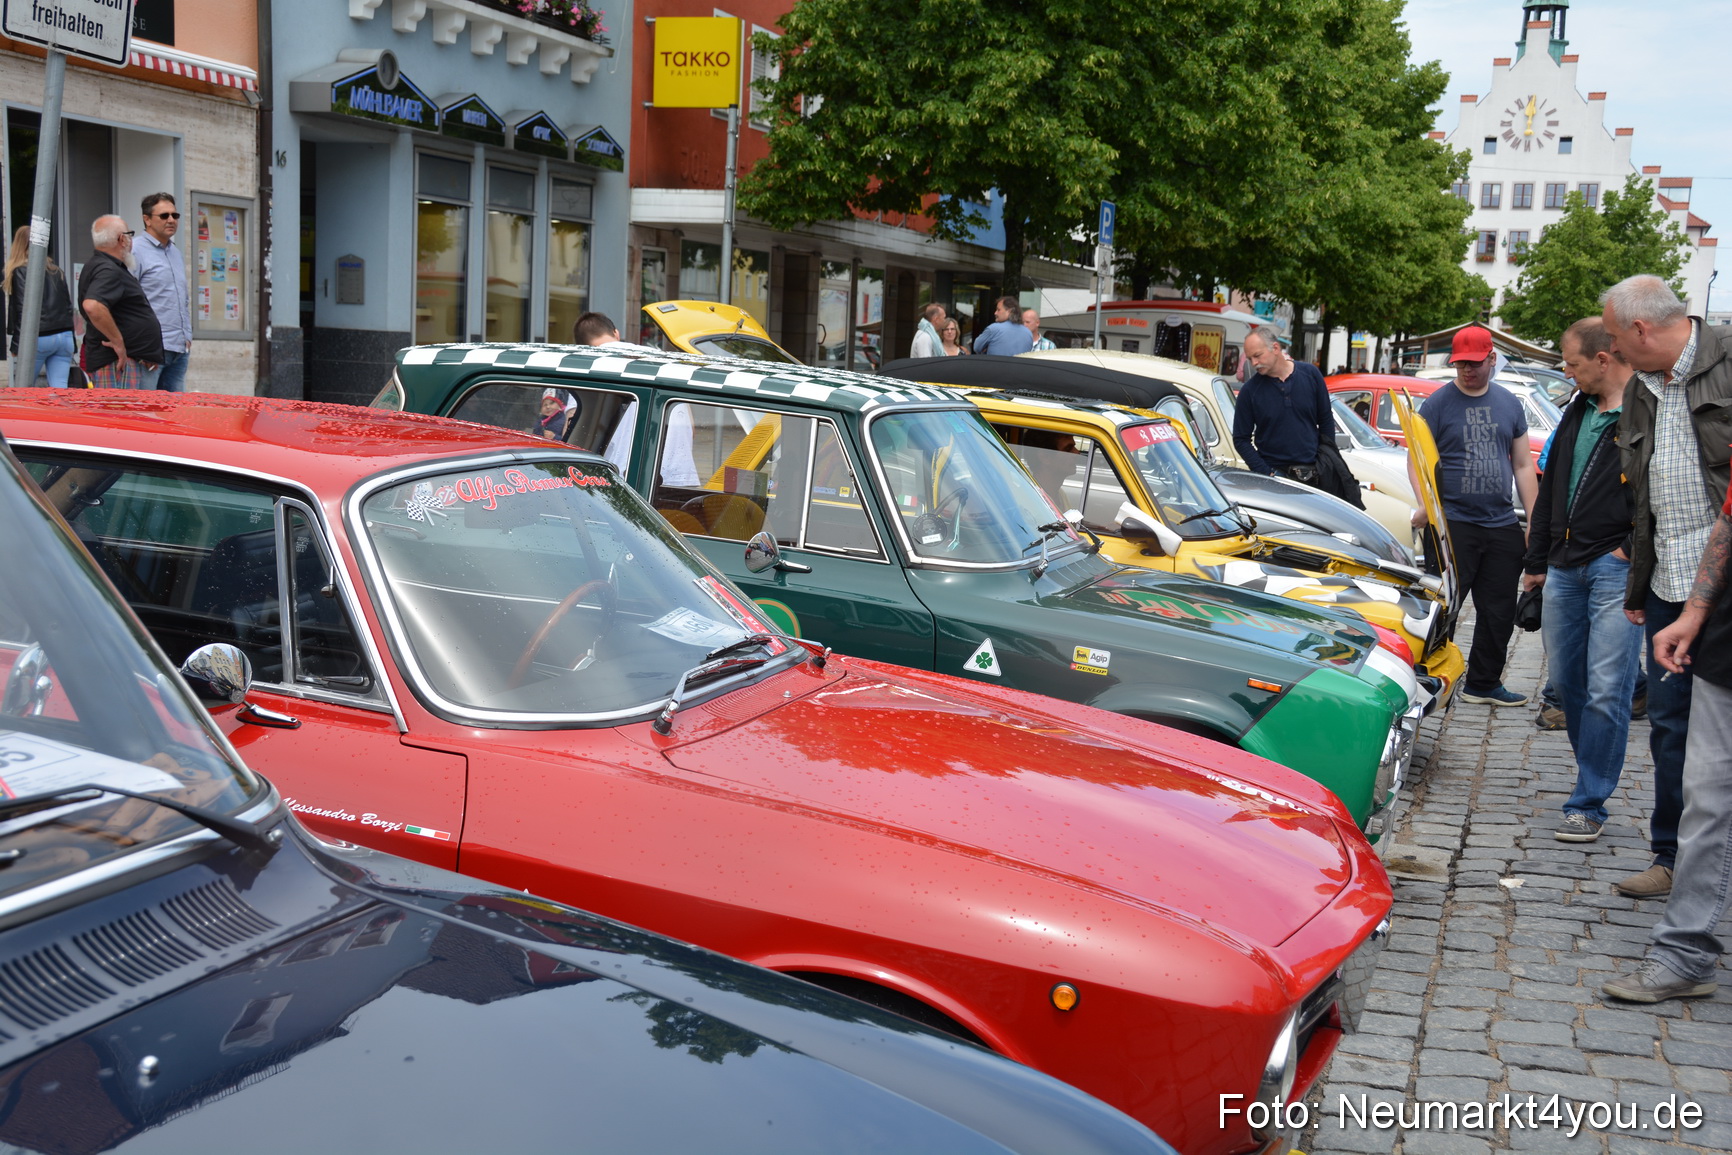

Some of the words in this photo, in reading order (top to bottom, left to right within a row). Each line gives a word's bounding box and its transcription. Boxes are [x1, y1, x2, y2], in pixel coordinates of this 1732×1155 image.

[32, 3, 104, 40] freihalten
[275, 149, 287, 168] 16
[1102, 207, 1112, 239] P
[1465, 406, 1492, 425] GET
[1463, 423, 1499, 443] LOST
[1464, 441, 1498, 460] FIND
[1463, 459, 1502, 478] YOUR
[455, 475, 515, 511] Alfa
[1461, 476, 1503, 495] BLISS
[1090, 652, 1108, 664] Agip
[1076, 665, 1107, 675] DUNLOP
[282, 797, 357, 822] lessandro
[360, 812, 403, 833] Borzi
